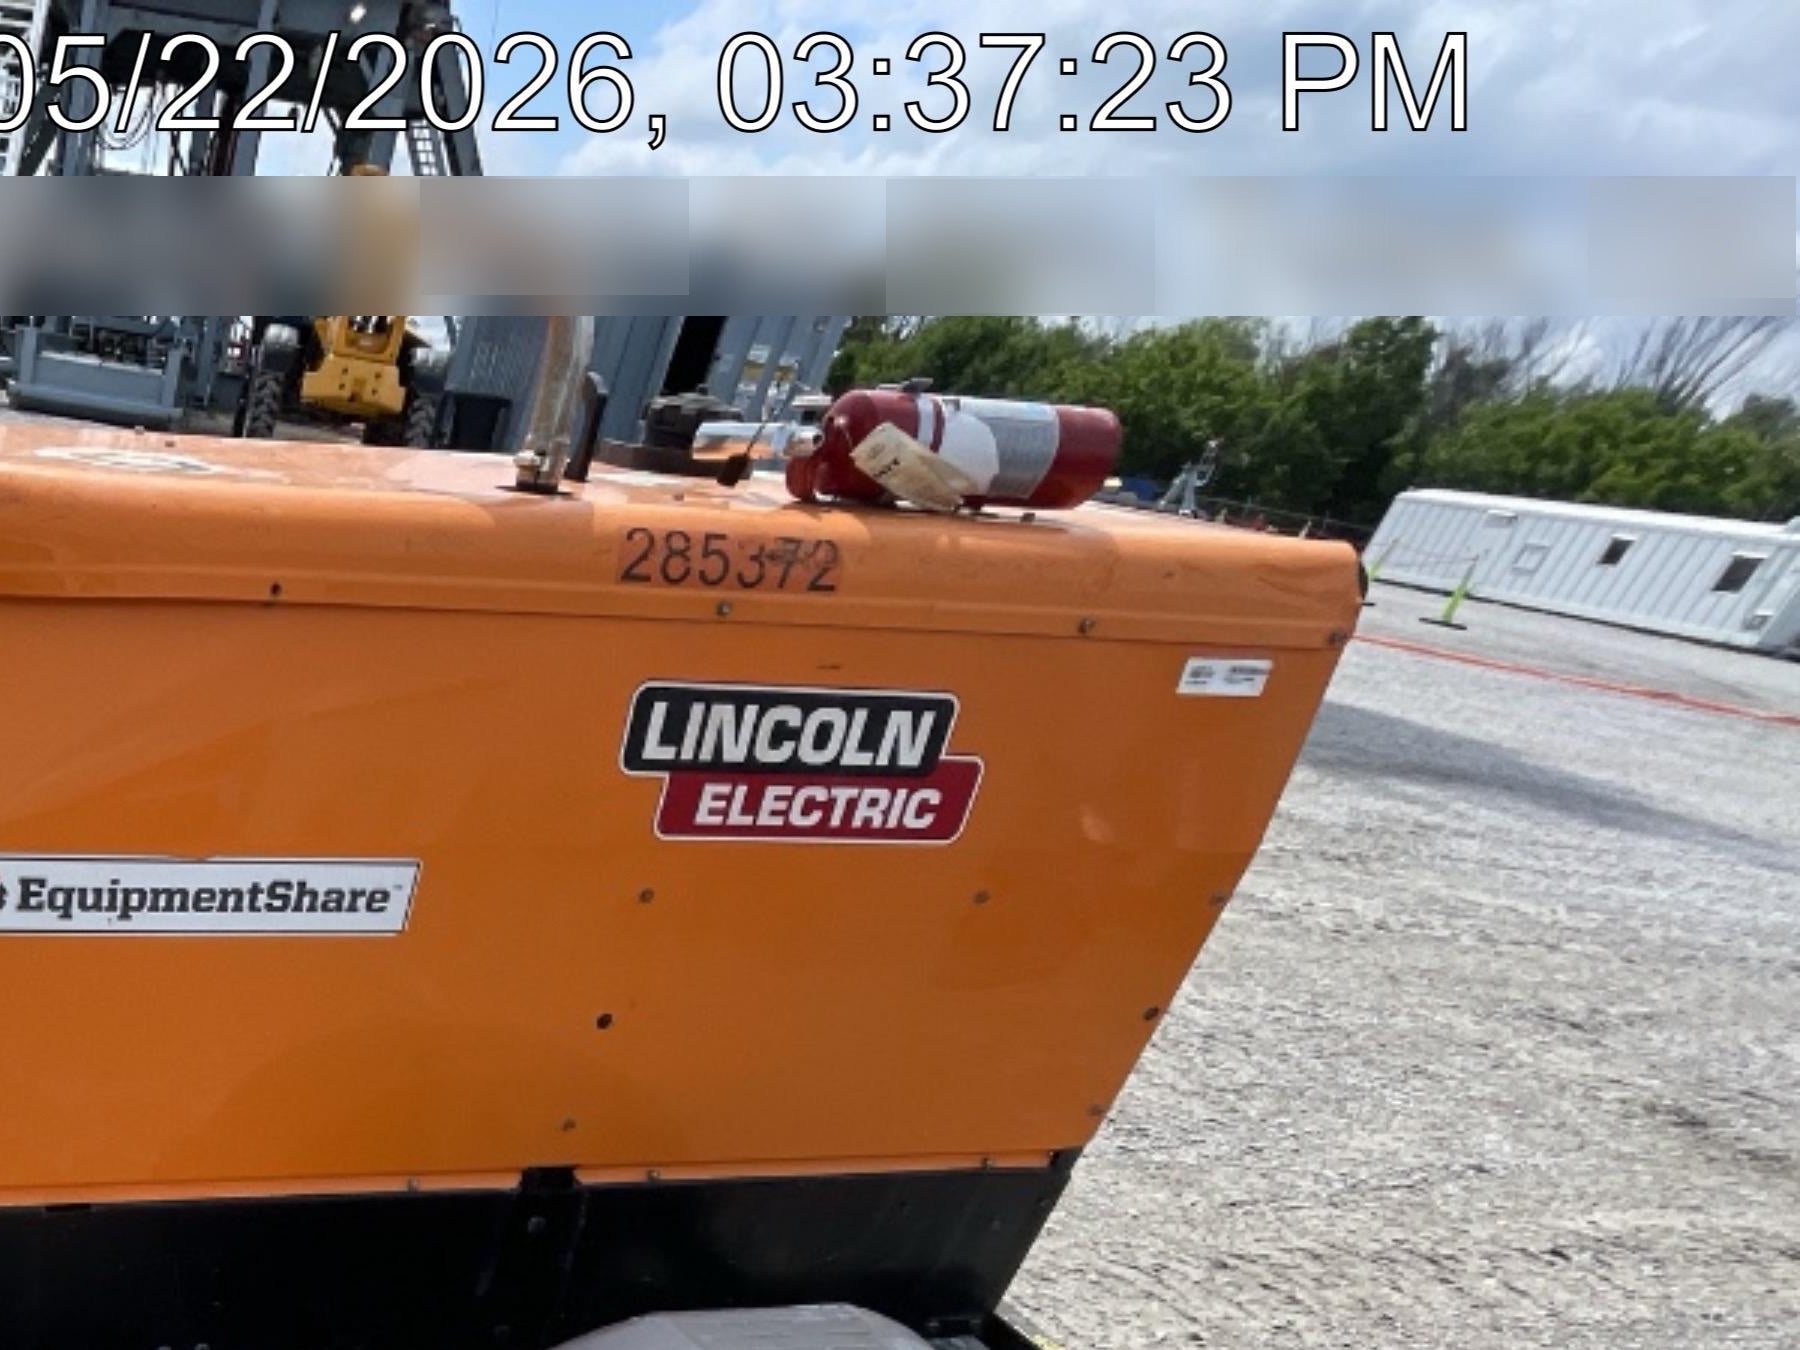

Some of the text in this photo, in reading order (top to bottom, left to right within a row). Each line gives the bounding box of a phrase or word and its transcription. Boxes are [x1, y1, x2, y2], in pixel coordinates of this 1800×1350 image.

[620, 526, 840, 592] 285372
[641, 701, 937, 768] LINCOLN
[694, 782, 943, 830] ELECTRIC
[16, 877, 391, 921] EquipmentShare
